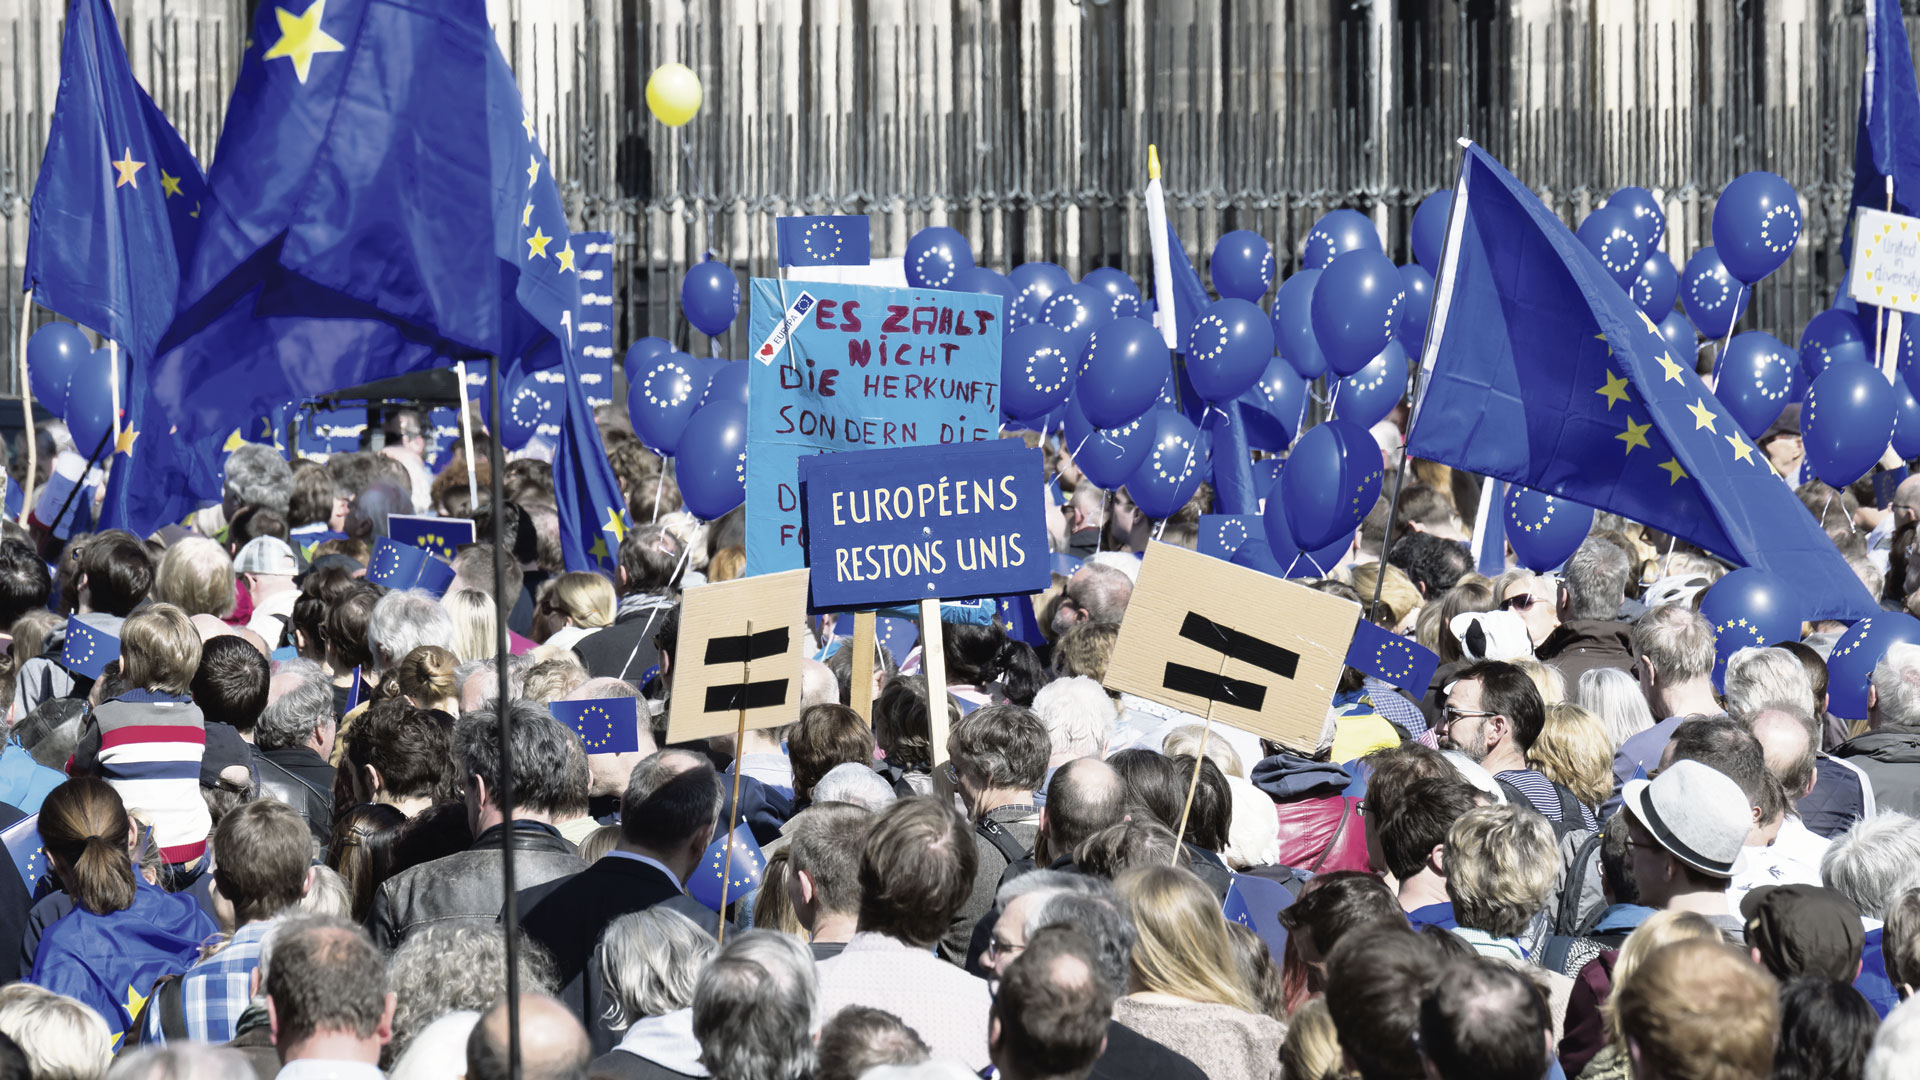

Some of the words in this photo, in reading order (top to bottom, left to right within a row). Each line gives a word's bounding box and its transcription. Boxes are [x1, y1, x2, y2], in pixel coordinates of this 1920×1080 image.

[1882, 238, 1917, 258] United
[816, 298, 862, 332] ES
[880, 296, 995, 336] ZÄHLT
[863, 374, 998, 413] HERKUNFT,
[776, 405, 917, 445] SONDERN
[832, 475, 1018, 526] EUROPÉENS
[836, 540, 946, 582] RESTONS
[956, 532, 1026, 571] UNIS
